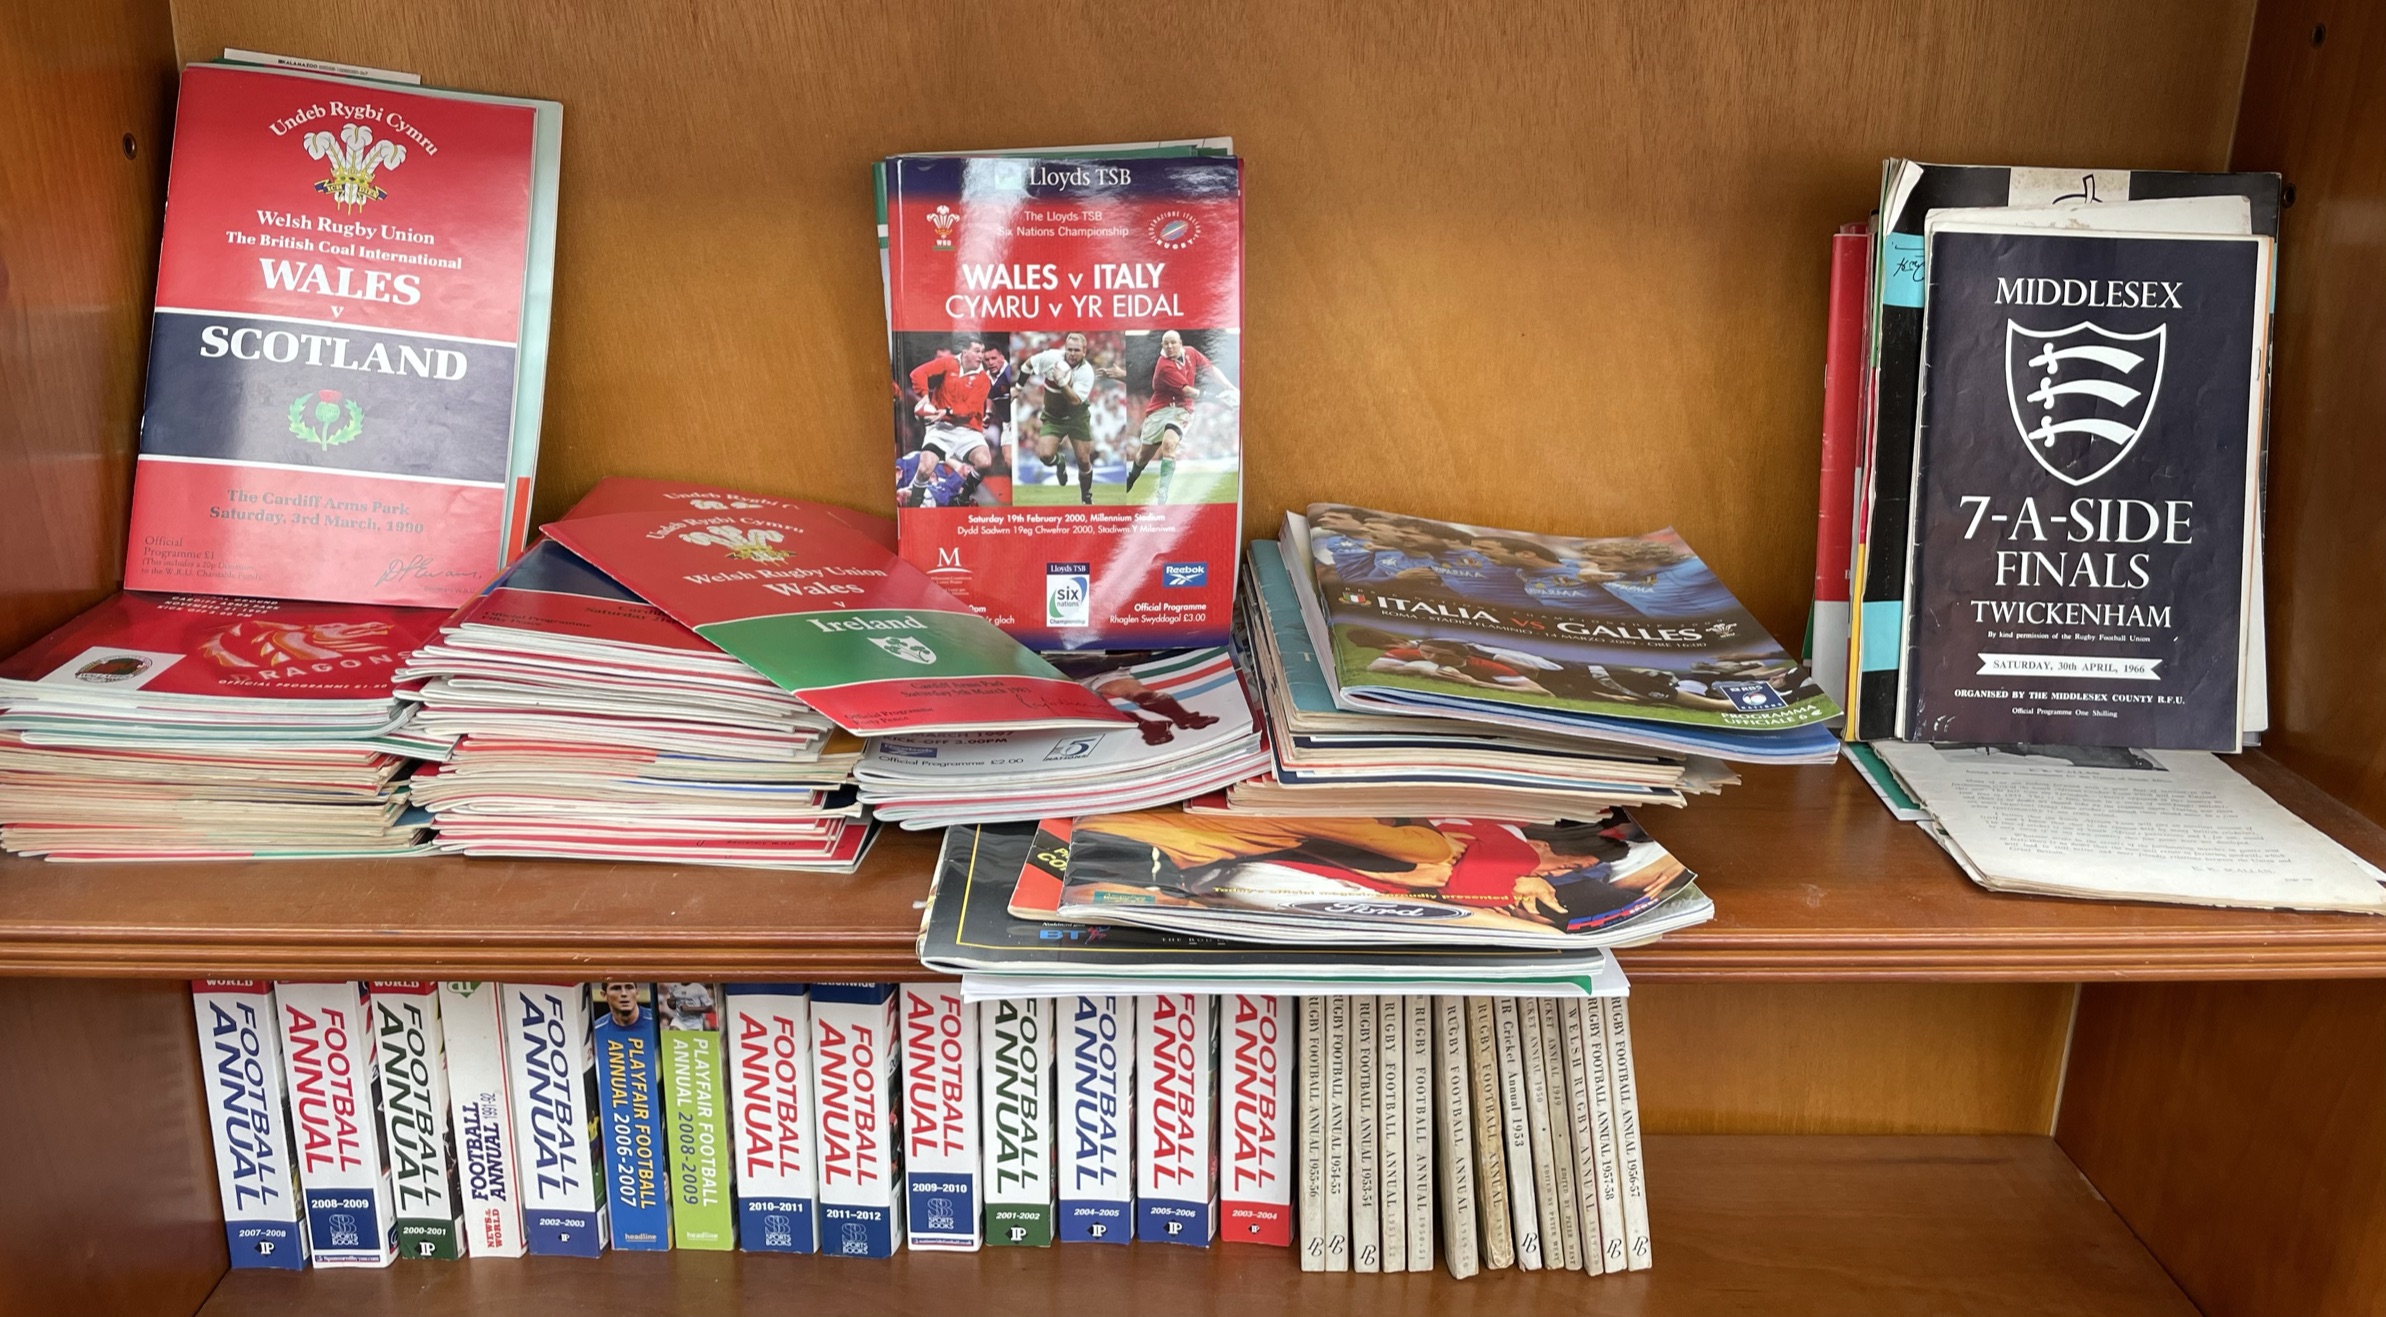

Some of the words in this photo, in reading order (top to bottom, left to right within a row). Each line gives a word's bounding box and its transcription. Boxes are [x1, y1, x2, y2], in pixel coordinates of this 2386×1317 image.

[269, 105, 326, 136] Undeb
[330, 101, 384, 122] Rygbi
[386, 112, 438, 156] Cymru
[1029, 168, 1090, 191] Lloyds
[1096, 167, 1132, 186] TSB
[257, 210, 312, 230] Welsh
[317, 217, 377, 239] Rugby
[381, 225, 435, 245] Union
[1016, 227, 1055, 238] Nations
[1058, 226, 1129, 239] Championship
[1024, 211, 1044, 222] The
[1046, 211, 1079, 223] Lloyds
[1081, 211, 1103, 222] TSB
[226, 231, 256, 245] The
[260, 235, 314, 251] British
[319, 241, 354, 256] Coal
[359, 246, 462, 269] International
[259, 258, 421, 306] WALES
[962, 264, 1058, 290] WALES
[1068, 273, 1083, 289] v
[1094, 263, 1165, 289] ITALY
[1994, 276, 2184, 309] MIDDLESEX
[331, 306, 343, 319] v
[945, 295, 1039, 319] CYMRU
[1048, 303, 1062, 318] v
[1071, 295, 1102, 318] YR
[1112, 294, 1184, 317] EIDAL
[200, 325, 468, 381] SCOTLAND
[228, 489, 258, 504] The
[262, 492, 323, 508] Cardiff
[324, 498, 368, 512] Arms
[372, 502, 410, 516] Park
[209, 506, 287, 526] Saturday,
[292, 512, 320, 525] 3rd
[325, 514, 381, 532] March,
[386, 521, 424, 534] 1990
[682, 516, 735, 526] Rygbi
[740, 517, 804, 534] Cymru
[957, 526, 979, 535] Dydd
[981, 526, 1010, 534] Sadwrn
[1013, 526, 1033, 536] 19eg
[1035, 525, 1070, 534] Chwefror
[1073, 525, 1095, 535] 2000,
[1098, 525, 1130, 533] Stadiwm
[968, 514, 1004, 525] Saturday
[1007, 514, 1024, 522] 19th
[1027, 514, 1062, 525] February
[1065, 514, 1088, 524] 2000,
[1090, 514, 1132, 522] Millennium
[1134, 514, 1165, 522] Stadium
[1959, 495, 2194, 545] 7-A-SIDE
[144, 536, 183, 547] Official
[144, 547, 202, 560] Programme
[683, 571, 757, 585] Welsh
[755, 567, 824, 579] Rugby
[822, 566, 888, 577] Union
[1051, 565, 1072, 573] Lloyds
[1166, 566, 1205, 574] Reebok
[1994, 550, 2151, 589] FINALS
[762, 582, 866, 597] Wales
[1057, 586, 1079, 600] six
[806, 615, 928, 633] Ireland
[994, 615, 1014, 626] gloch
[1110, 615, 1139, 625] Rhaglen
[1141, 614, 1181, 625] Swyddogol
[1183, 613, 1206, 622] £3.00
[1134, 603, 1161, 611] Official
[1163, 603, 1207, 612] Programme
[1377, 596, 1500, 624] ITALIA
[1511, 617, 1545, 630] VS
[1557, 622, 1703, 641] GALLES
[1381, 610, 1418, 620] ROMA
[1429, 616, 1472, 625] STADIO
[1476, 622, 1533, 635] FLAMINIO
[1970, 599, 2172, 628] TWICKENHAM
[1987, 631, 1997, 639] By
[2016, 632, 2049, 640] permission
[2074, 633, 2096, 641] Rugby
[2099, 634, 2126, 642] Football
[1993, 660, 2053, 671] SATURDAY,
[2057, 662, 2077, 671] 30th
[2081, 663, 2118, 673] APRIL,
[2123, 664, 2145, 673] 1966
[1721, 705, 1817, 719] PROGRAMMA
[1954, 689, 2009, 699] ORGANISED
[2011, 691, 2026, 700] BY
[2028, 691, 2048, 700] THE
[2050, 692, 2108, 702] MIDDLESEX
[2112, 694, 2154, 703] COUNTY
[2157, 695, 2186, 705] R.F.U.
[2011, 707, 2034, 715] Official
[2036, 708, 2073, 717] Programme
[2092, 709, 2118, 718] Shilling
[1724, 716, 1796, 725] UFFICIALE
[879, 755, 919, 765] Official
[921, 759, 985, 767] Programme
[1324, 901, 1424, 917] Ford
[1383, 892, 1437, 900] proudly
[1513, 894, 1531, 902] by
[1040, 929, 1083, 940] BT
[1360, 1002, 1370, 1046] RUGBY
[1385, 1002, 1395, 1051] RUGBY
[1588, 997, 1601, 1041] RUGBY
[1503, 1021, 1515, 1064] Cricket
[1568, 1007, 1582, 1068] WELSH
[286, 1004, 334, 1173] ANNUAL
[608, 1040, 626, 1108] ANNUAL
[628, 1037, 650, 1120] PLAYFAIR
[673, 1038, 692, 1107] ANNUAL
[693, 1038, 712, 1118] PLAYFAIR
[1360, 1048, 1371, 1112] FOOTBALL
[209, 1000, 260, 1211] ANNUAL
[236, 1001, 279, 1206] FOOTBALL
[321, 1007, 361, 1172] FOOTBALL
[377, 1000, 423, 1211] ANNUAL
[403, 1002, 442, 1206] FOOTBALL
[520, 991, 560, 1200] ANNUAL
[545, 993, 579, 1196] FOOTBALL
[739, 1011, 774, 1178] ANNUAL
[773, 1015, 800, 1178] FOOTBALL
[995, 999, 1020, 1194] ANNUAL
[1020, 998, 1038, 1189] FOOTBALL
[1385, 1062, 1396, 1140] FOOTBALL
[1508, 1072, 1521, 1111] Annual
[1535, 1081, 1543, 1103] 1950
[1574, 1077, 1587, 1135] RUGBY
[1360, 1116, 1371, 1163] ANNUAL
[1512, 1118, 1525, 1147] 1953
[463, 1102, 488, 1200] FOOTBALL
[484, 1122, 506, 1202] ANNUAL
[614, 1113, 637, 1207] 2006-2007
[635, 1124, 656, 1209] FOOTBALL
[678, 1112, 699, 1205] 2008-2009
[699, 1122, 718, 1207] FOOTBALL
[912, 1183, 967, 1193] 2009-2010
[1361, 1166, 1372, 1207] 1953-54
[1386, 1150, 1397, 1208] ANNUAL
[1580, 1145, 1595, 1212] ANNUAL
[311, 1199, 369, 1209] 2008-2009
[749, 1202, 803, 1212] 2010-2011
[827, 1210, 881, 1220] 2011-2012
[239, 1229, 286, 1238] 2007-2008
[403, 1227, 447, 1236] 2000-2001
[485, 1217, 495, 1247] NEWS
[492, 1208, 502, 1247] WORLD
[625, 1233, 657, 1241] headline
